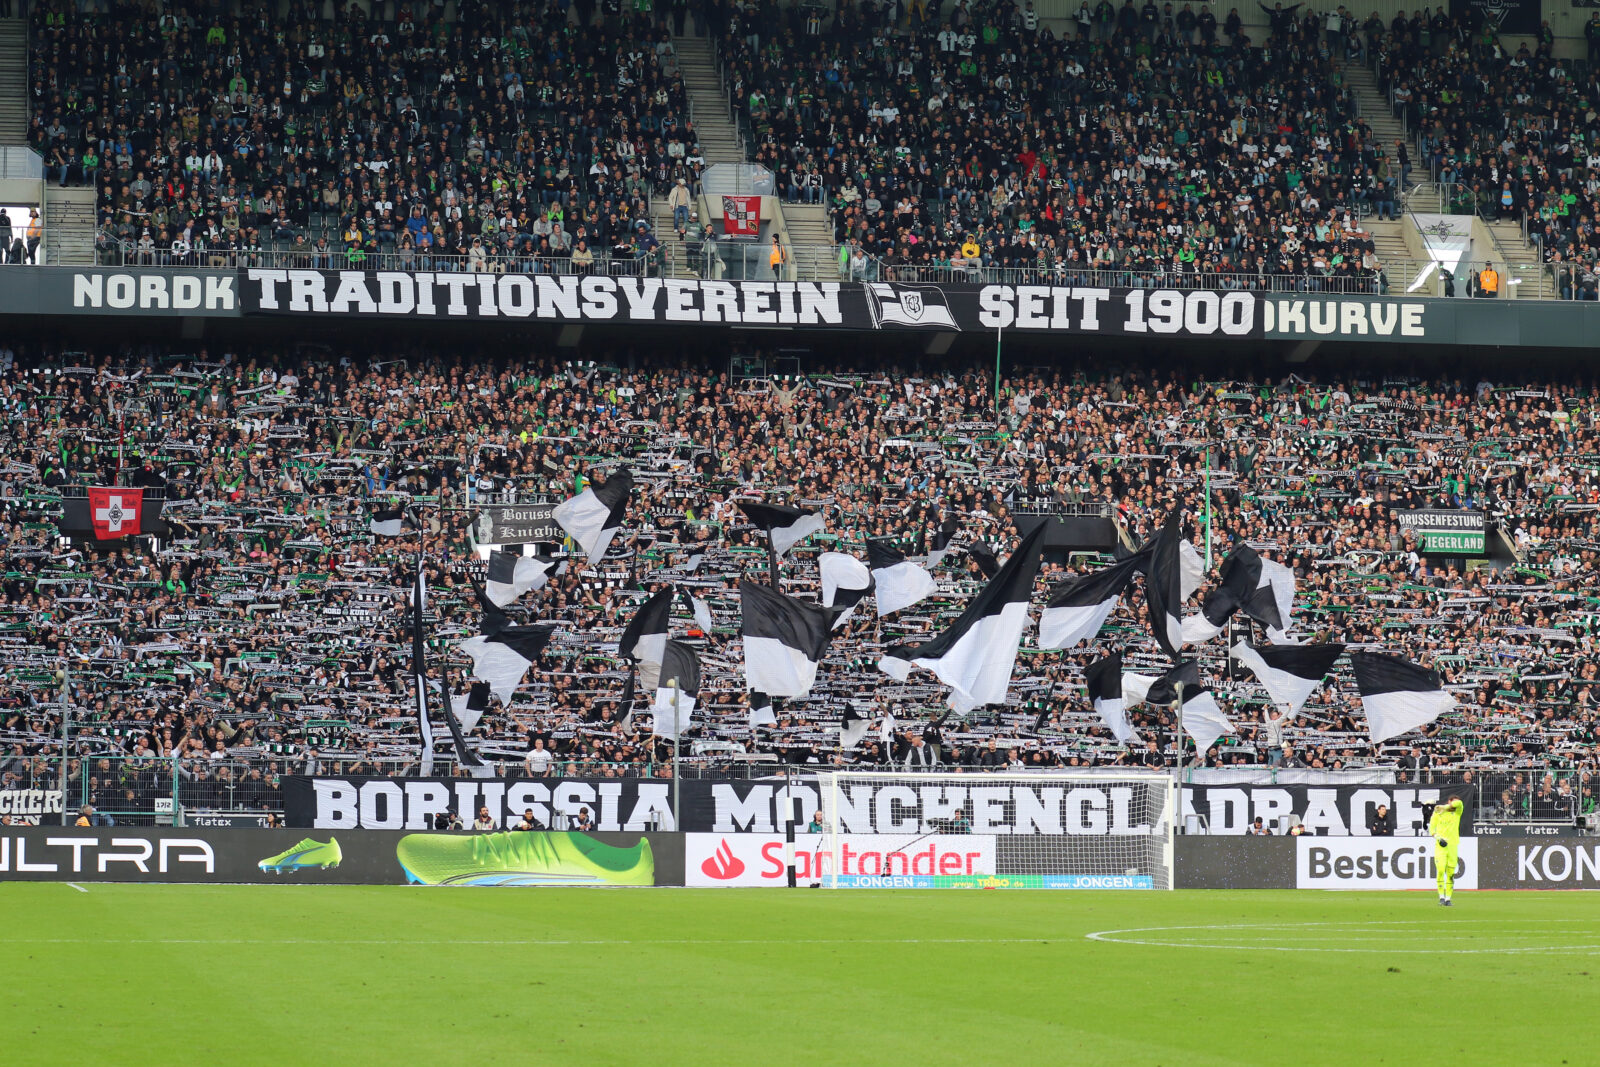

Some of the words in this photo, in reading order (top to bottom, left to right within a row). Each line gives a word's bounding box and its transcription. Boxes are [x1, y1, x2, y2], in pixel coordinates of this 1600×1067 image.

[248, 268, 842, 325] TRADITIONSVEREIN
[979, 283, 1110, 330] SEIT
[1124, 288, 1255, 336] 1900
[502, 508, 553, 522] Boruss
[1398, 513, 1484, 527] ORUSSENFESTUNG
[500, 525, 565, 540] Knights
[313, 779, 675, 832] BORUSSIA
[712, 780, 1441, 836] MÖNCHENGLADBACH
[194, 817, 232, 827] flatex
[1472, 826, 1502, 835] latex
[1524, 826, 1559, 835] flatex
[760, 841, 981, 879] Santander
[851, 876, 914, 888] JONGEN
[1072, 876, 1133, 888] JONGEN
